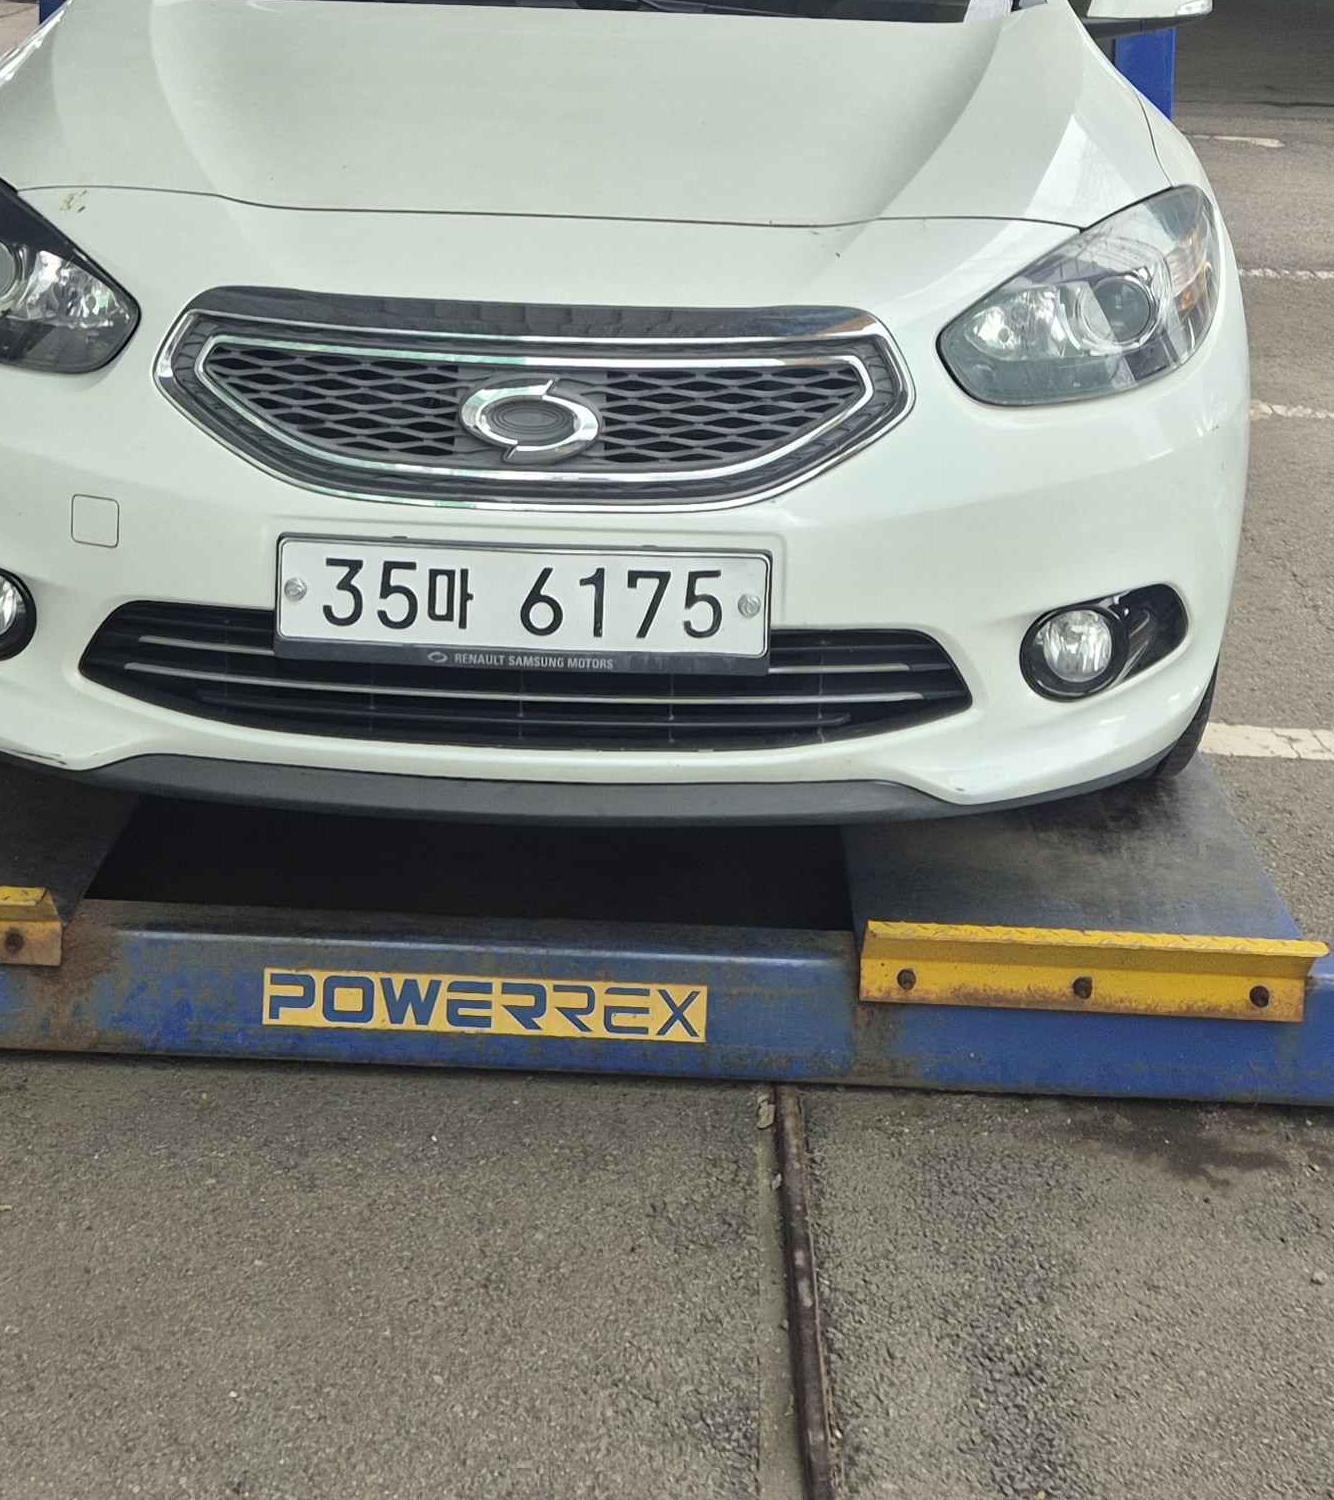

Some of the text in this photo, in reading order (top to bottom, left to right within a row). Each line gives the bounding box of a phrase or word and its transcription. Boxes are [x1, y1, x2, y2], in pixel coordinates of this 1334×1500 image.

[322, 557, 723, 639] 35마 6175
[454, 653, 614, 670] RENAULT SAMSUNG MOTORS
[268, 972, 701, 1039] POWERREX
